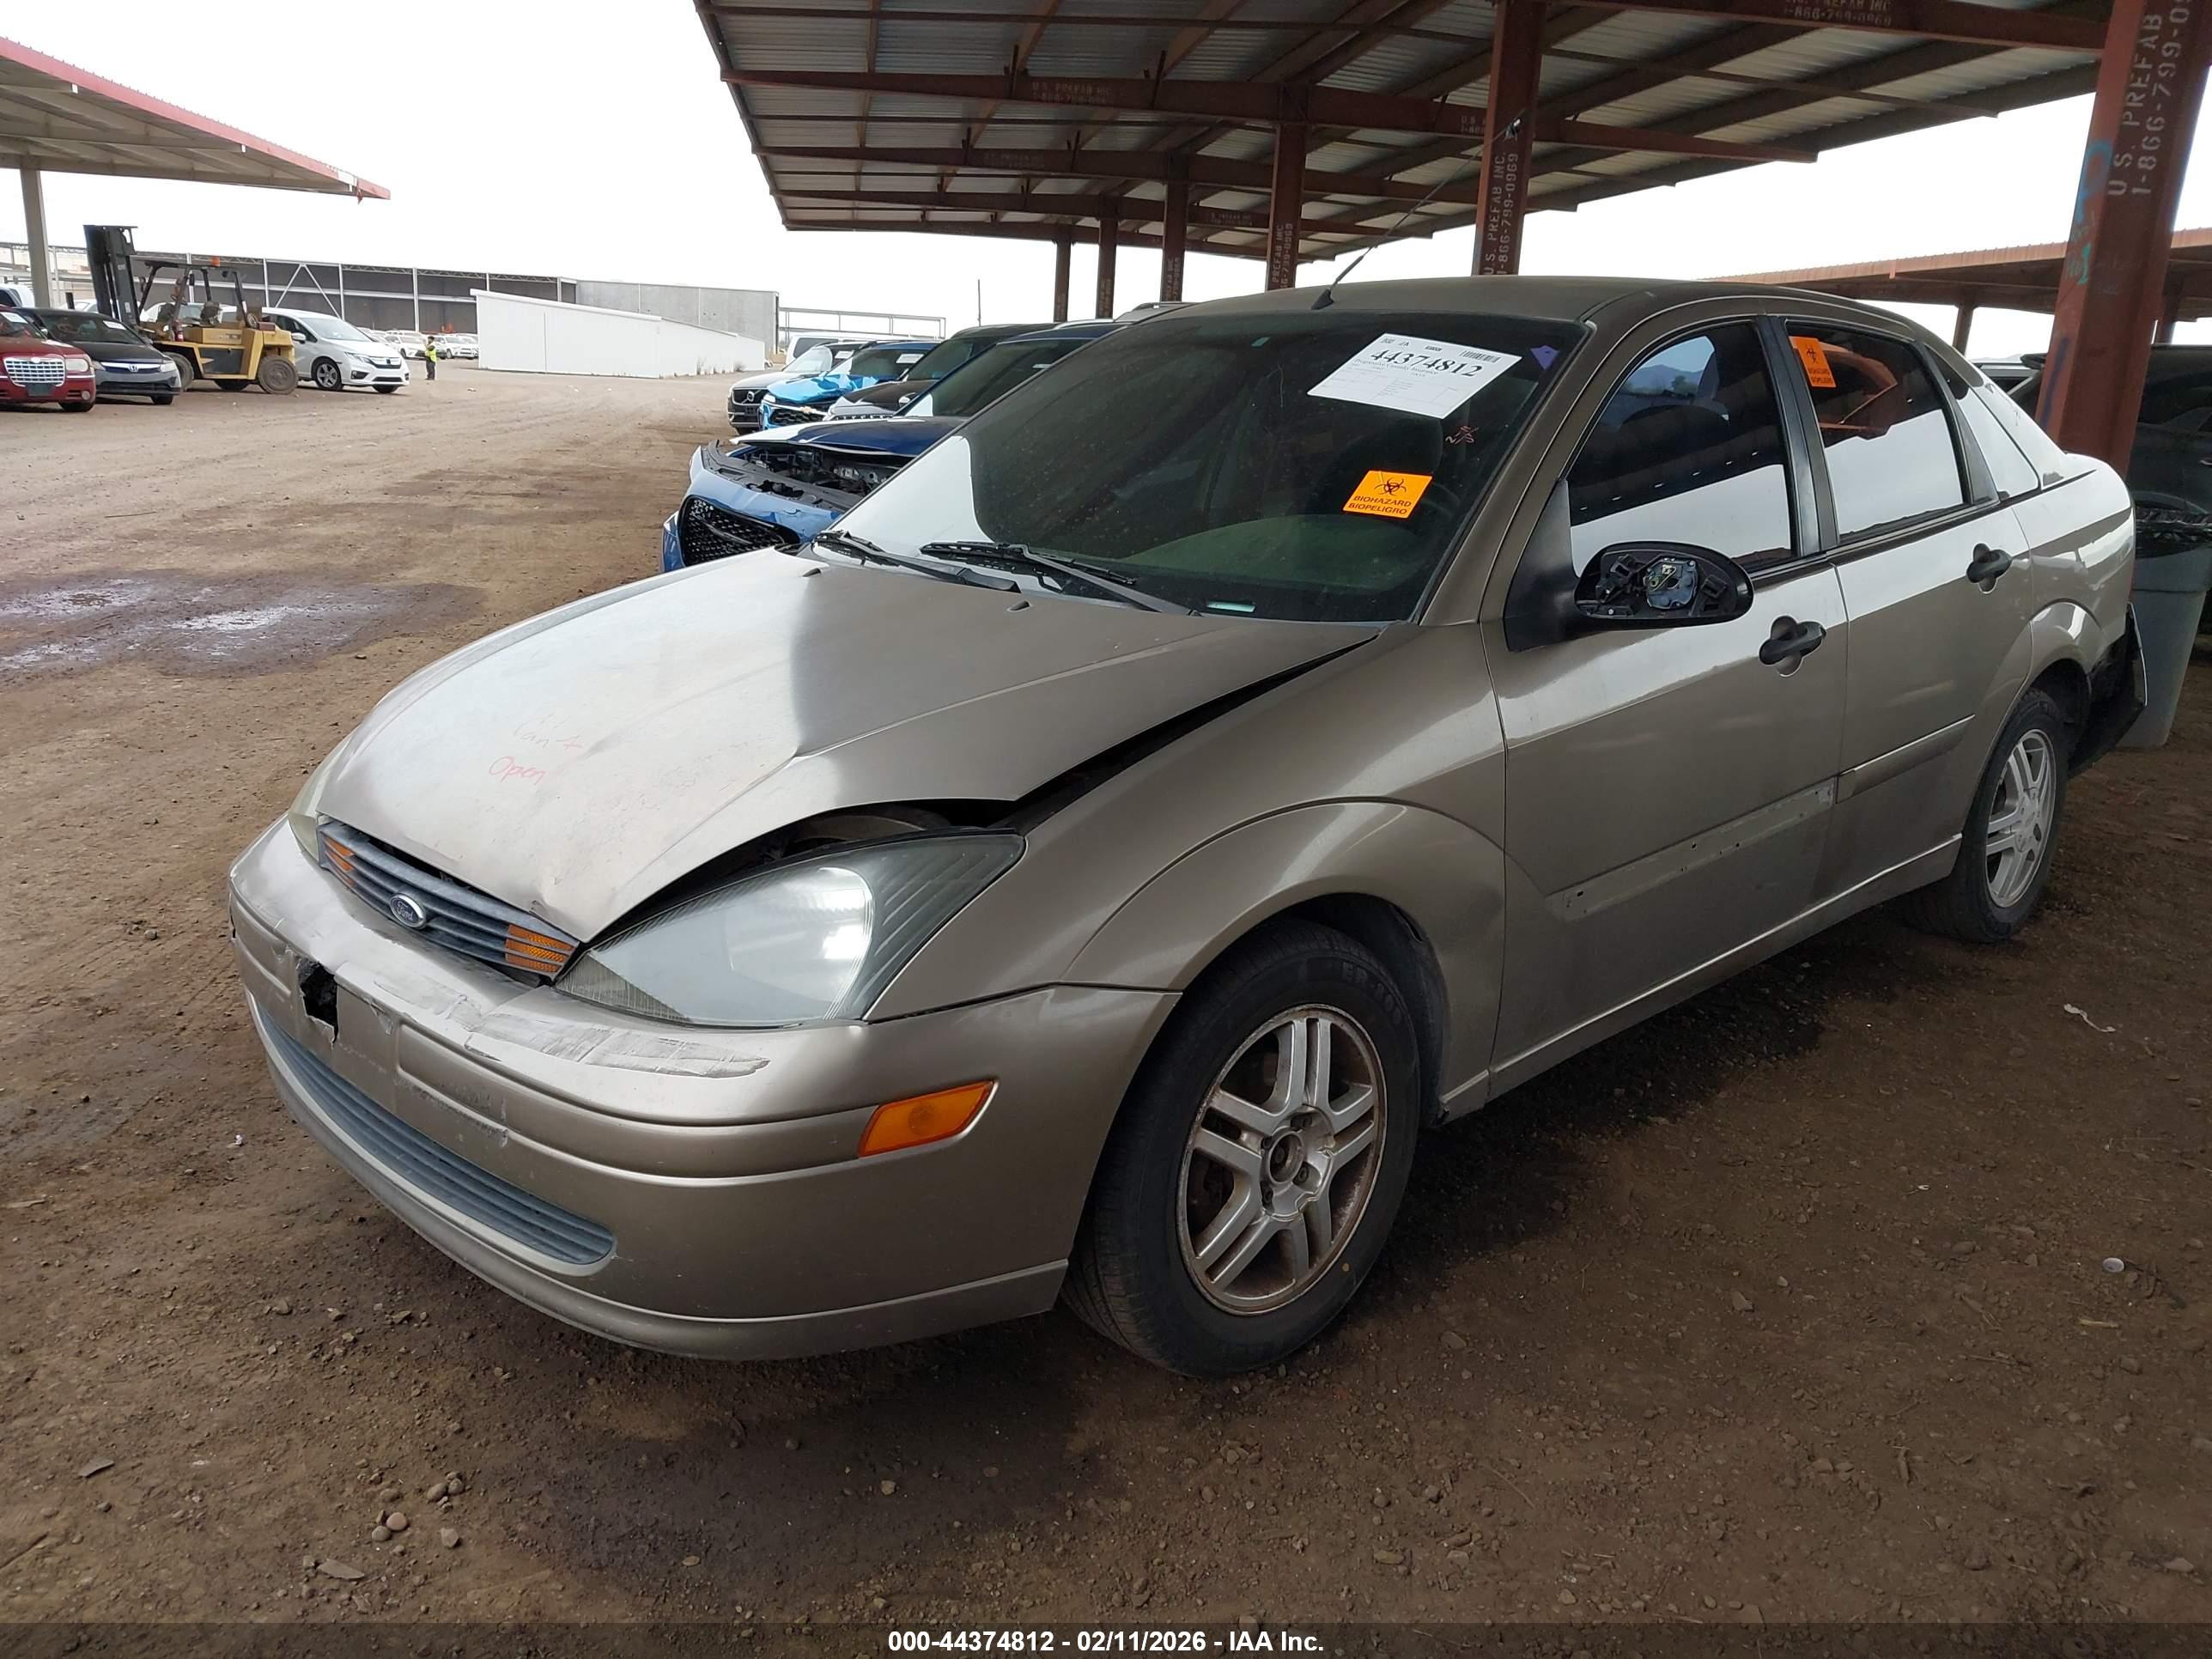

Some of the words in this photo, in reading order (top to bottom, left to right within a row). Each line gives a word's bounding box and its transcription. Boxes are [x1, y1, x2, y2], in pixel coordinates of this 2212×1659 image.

[2123, 13, 2163, 126] PREFAB
[2131, 0, 2191, 195] 1-866-799-0
[1487, 186, 1503, 241] PREFAB
[1497, 153, 1519, 275] 1-866-799-0969
[1370, 349, 1483, 377] 44374812
[1348, 502, 1407, 514] BIOPELIGRO
[1353, 495, 1412, 507] BIOHAZARD
[489, 756, 546, 786] Open
[397, 900, 414, 921] Ford
